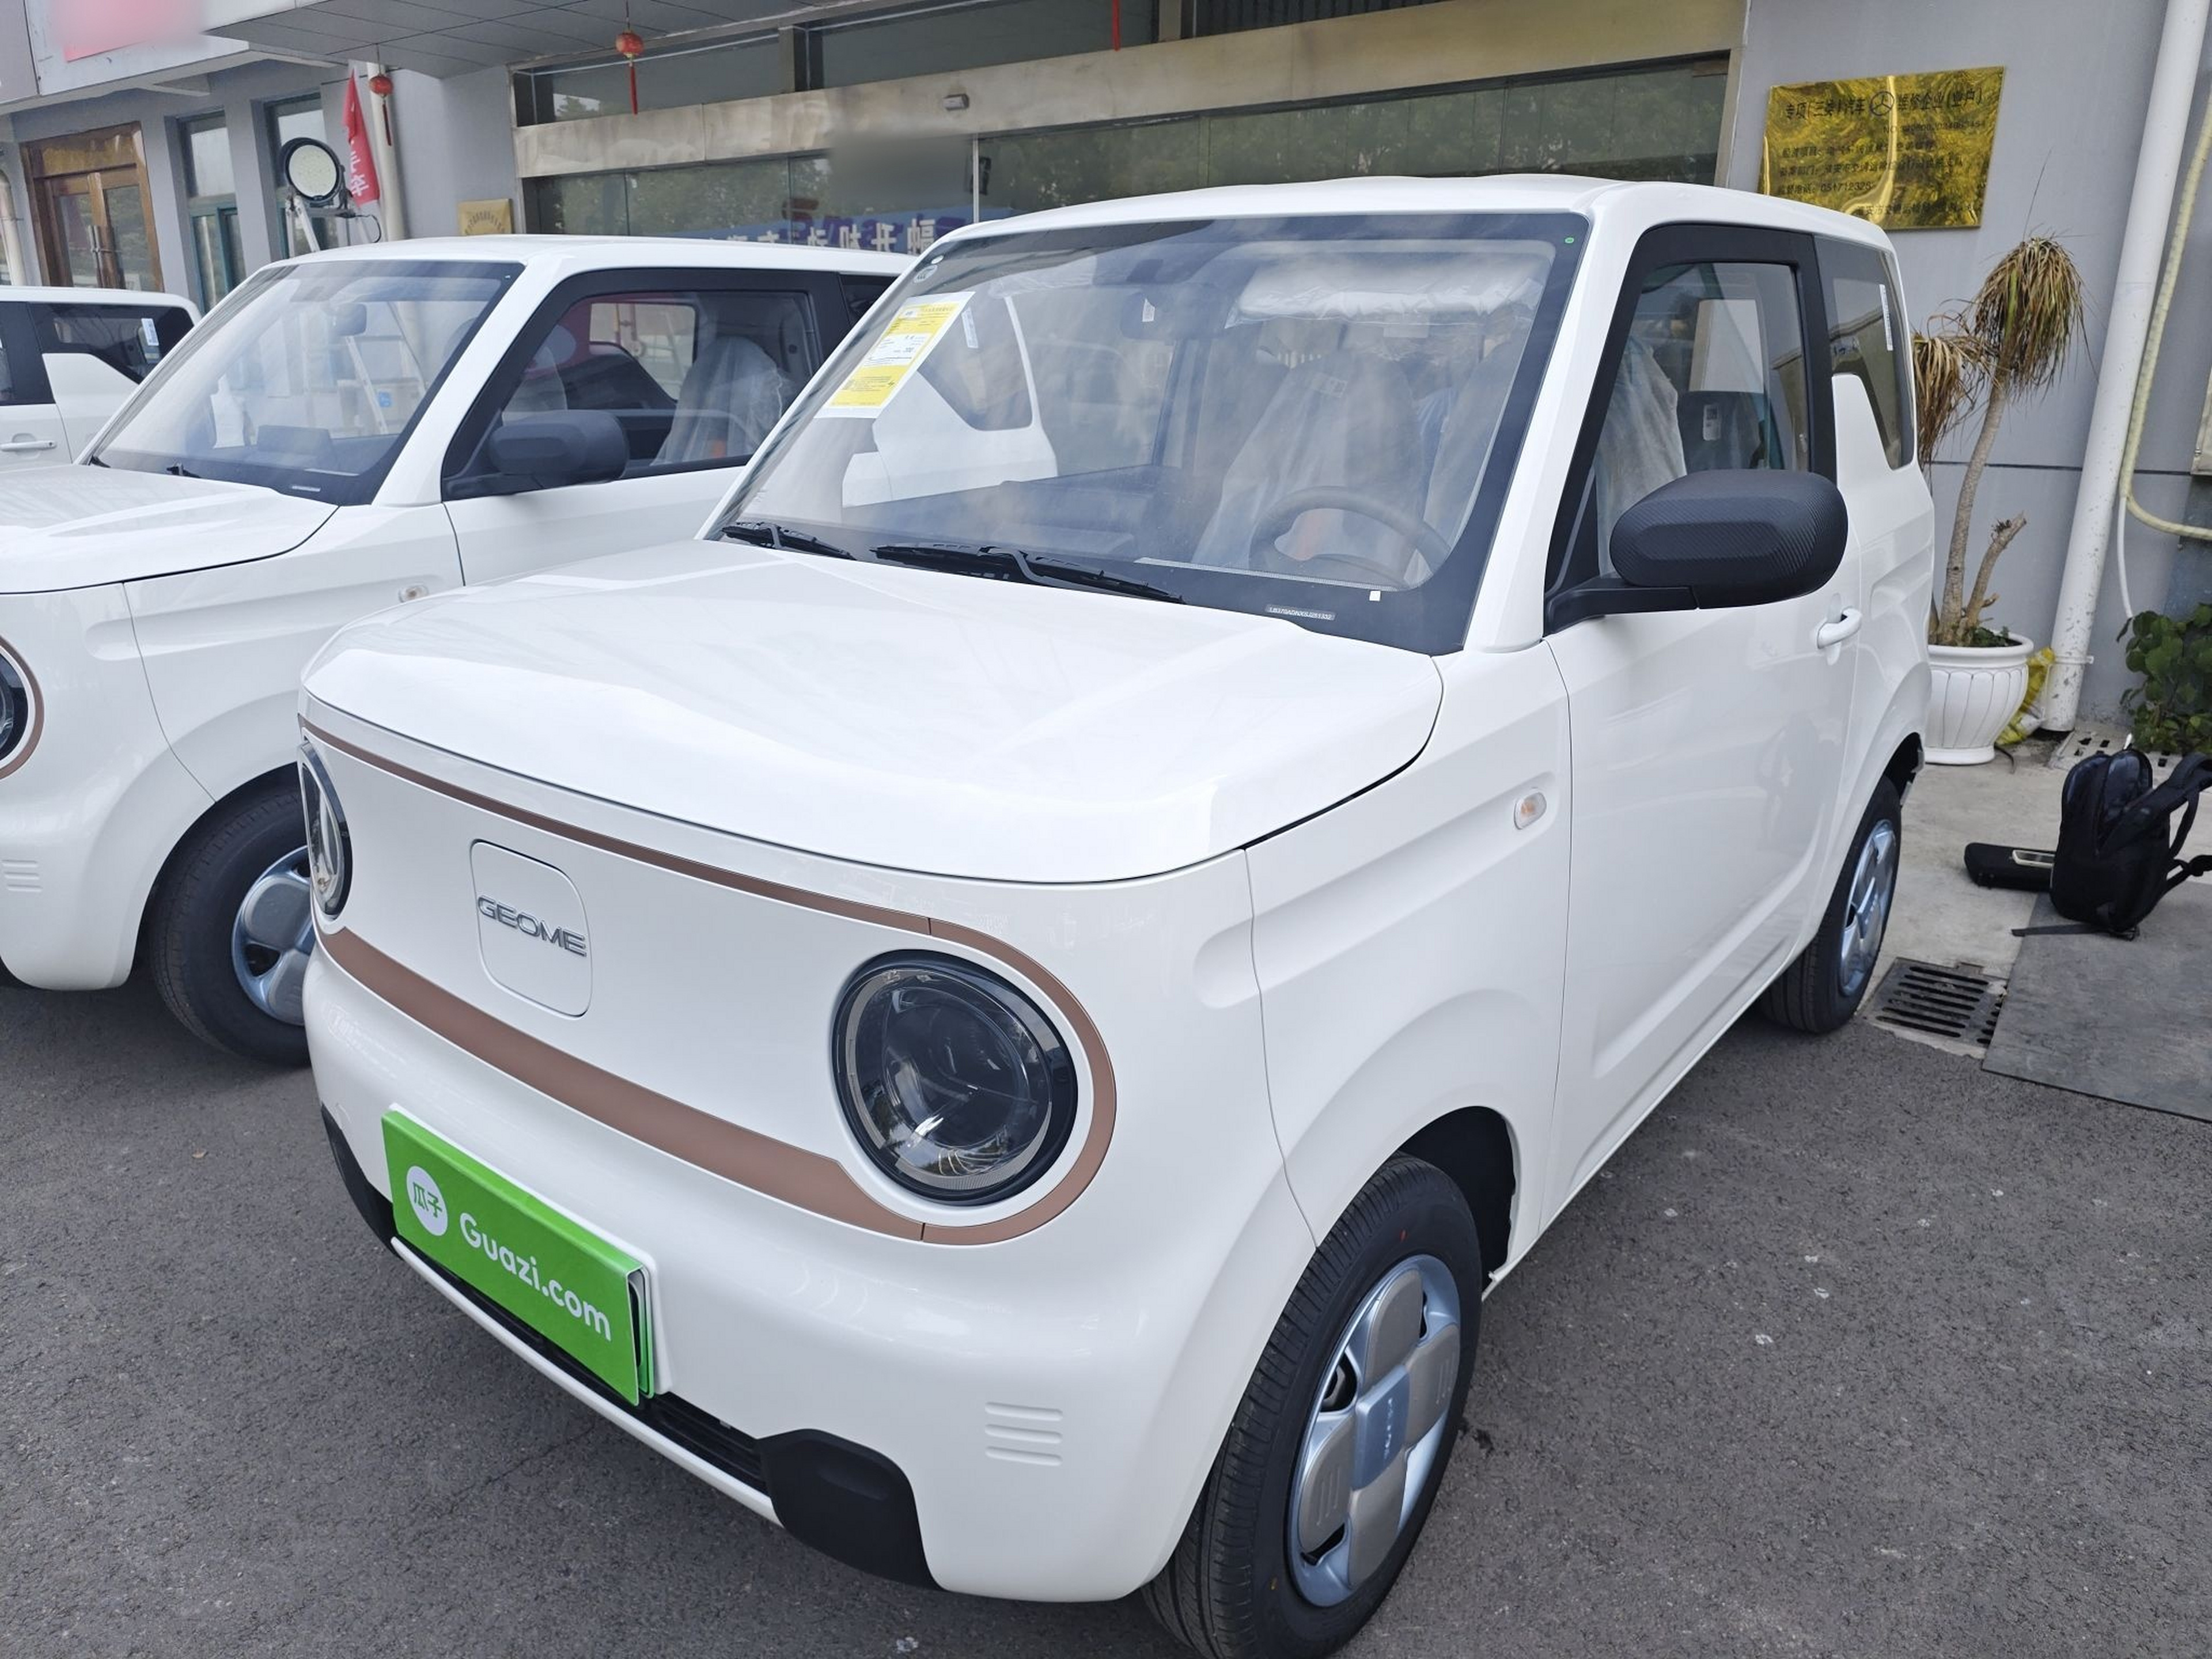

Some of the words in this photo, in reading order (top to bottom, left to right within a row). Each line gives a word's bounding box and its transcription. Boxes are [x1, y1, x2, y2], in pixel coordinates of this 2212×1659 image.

[478, 895, 587, 957] GEOME
[412, 1181, 443, 1218] 瓜子
[459, 1213, 611, 1342] Guazi.com
